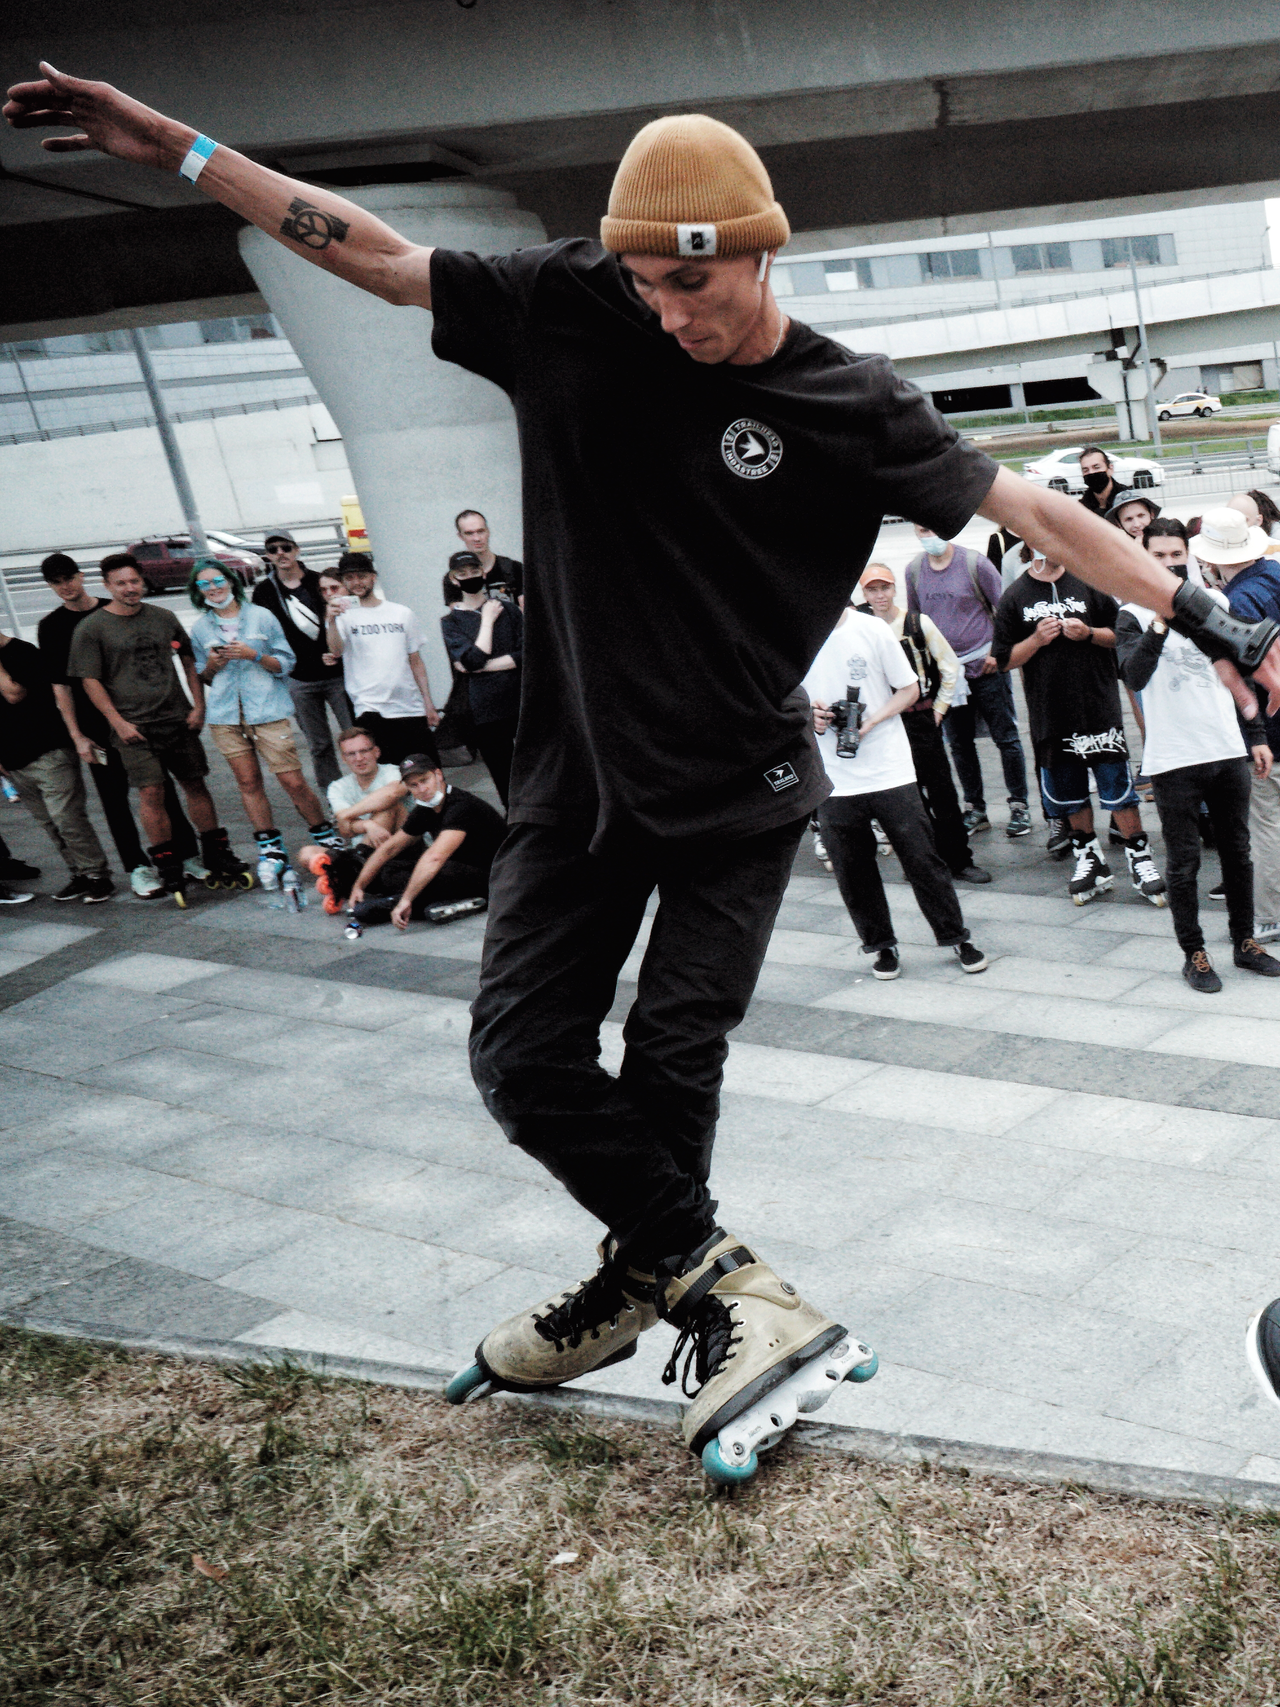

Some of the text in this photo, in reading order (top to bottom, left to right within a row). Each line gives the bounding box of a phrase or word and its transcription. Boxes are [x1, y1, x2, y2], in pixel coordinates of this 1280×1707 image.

[726, 450, 769, 476] INDASTREE
[360, 622, 405, 635] ZOO YORK
